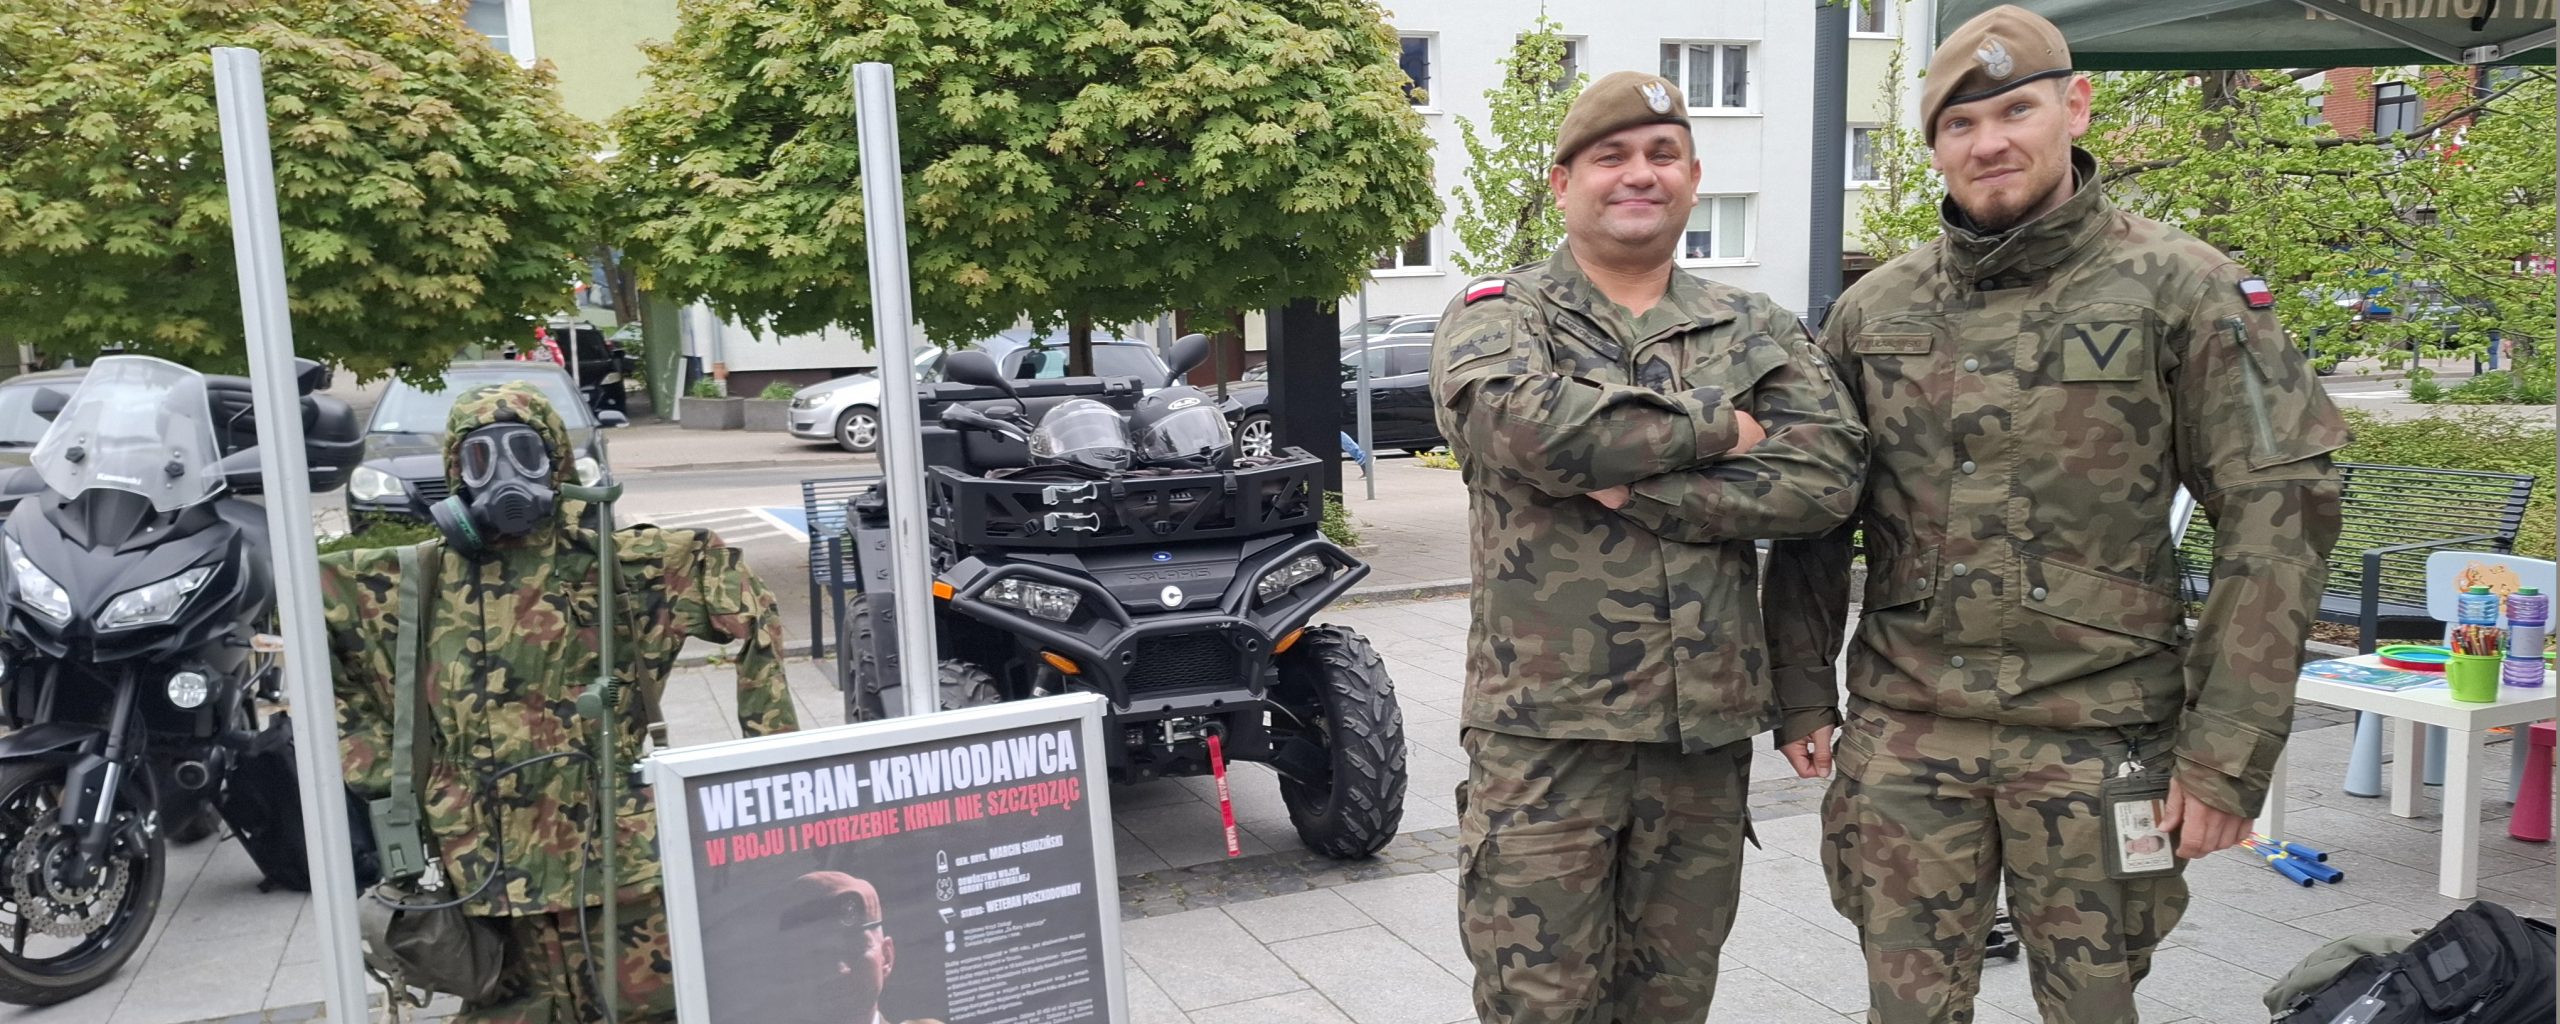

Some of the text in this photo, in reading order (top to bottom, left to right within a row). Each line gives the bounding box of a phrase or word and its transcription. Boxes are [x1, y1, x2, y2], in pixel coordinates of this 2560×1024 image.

[1124, 567, 1212, 584] POLARIS
[699, 730, 1078, 832] WETERAN-KRWIODAWCA
[705, 776, 1081, 867] W BOJU I POTRZEBIE KRWI NIE SZCZĘDZĄC
[989, 843, 1021, 860] MARCIN
[986, 895, 1022, 913] WETERAN
[1022, 882, 1081, 905] POSZKODOWANY
